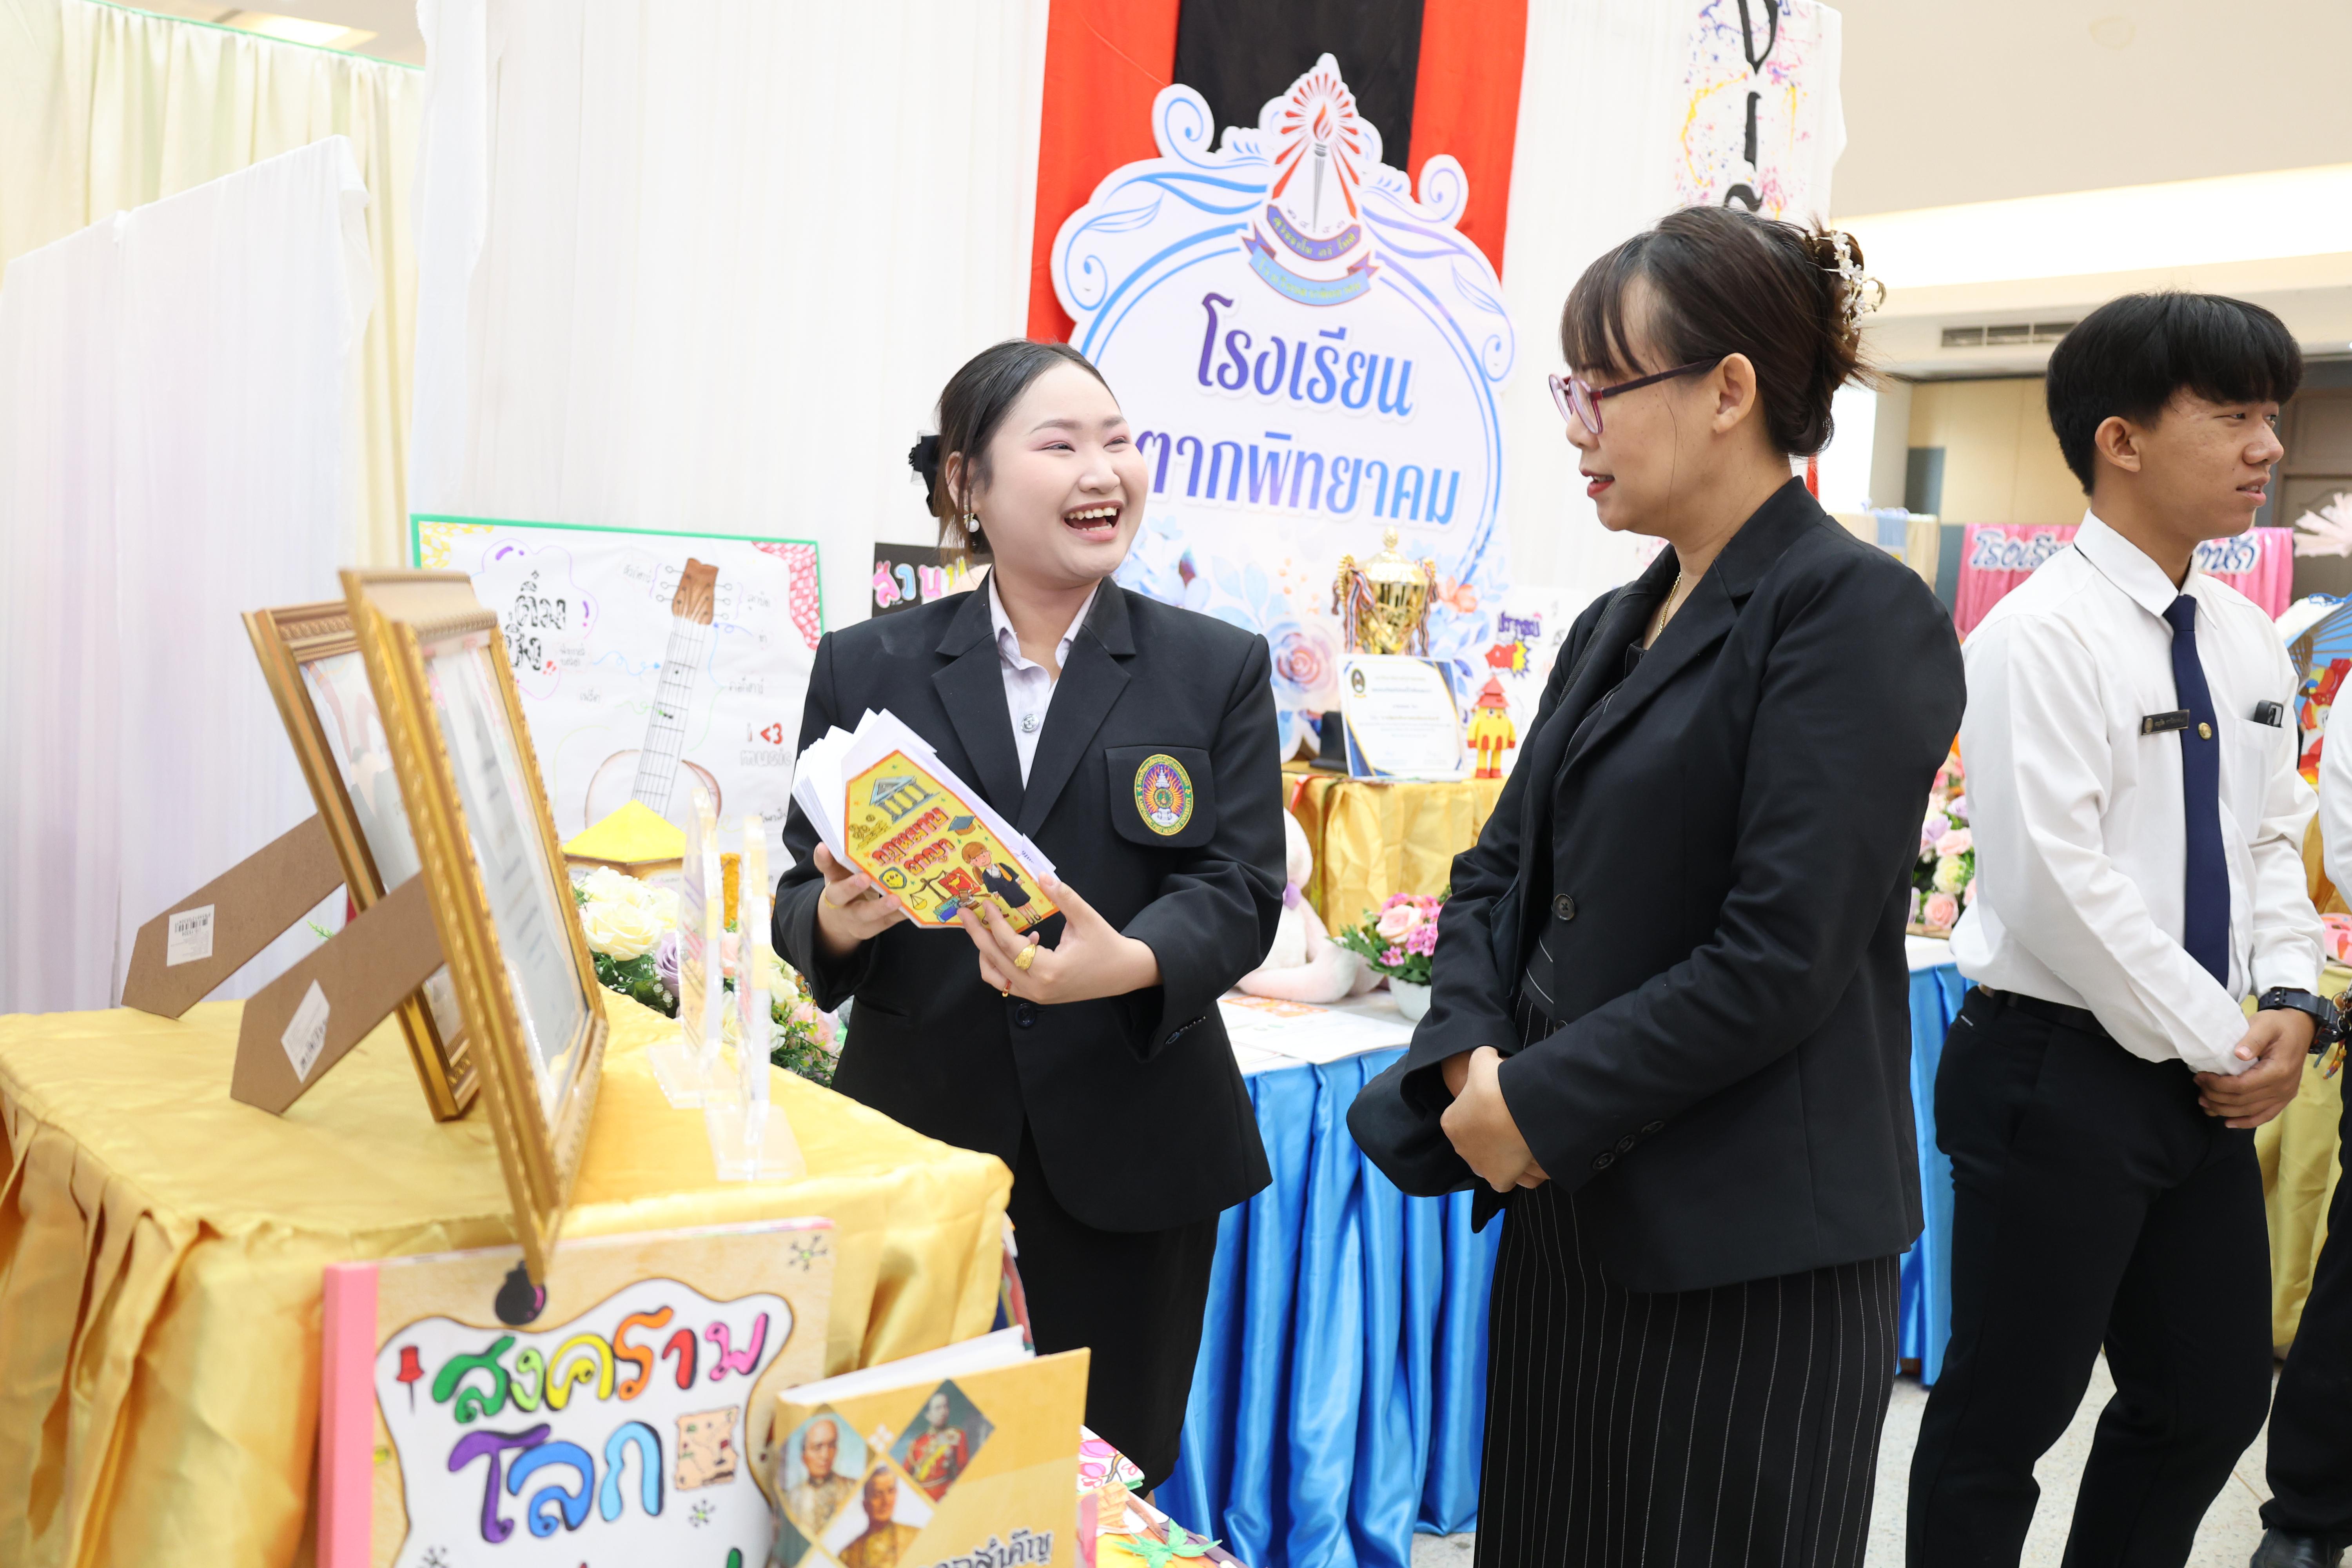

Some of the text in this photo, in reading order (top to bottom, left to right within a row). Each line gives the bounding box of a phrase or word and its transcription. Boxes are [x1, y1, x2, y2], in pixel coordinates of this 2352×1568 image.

[1198, 292, 1412, 416] โรงเรียน
[1137, 430, 1461, 525] ตากพิทยาคม
[740, 747, 792, 767] music
[432, 1305, 770, 1425] สงคราม
[448, 1420, 665, 1544] โลก
